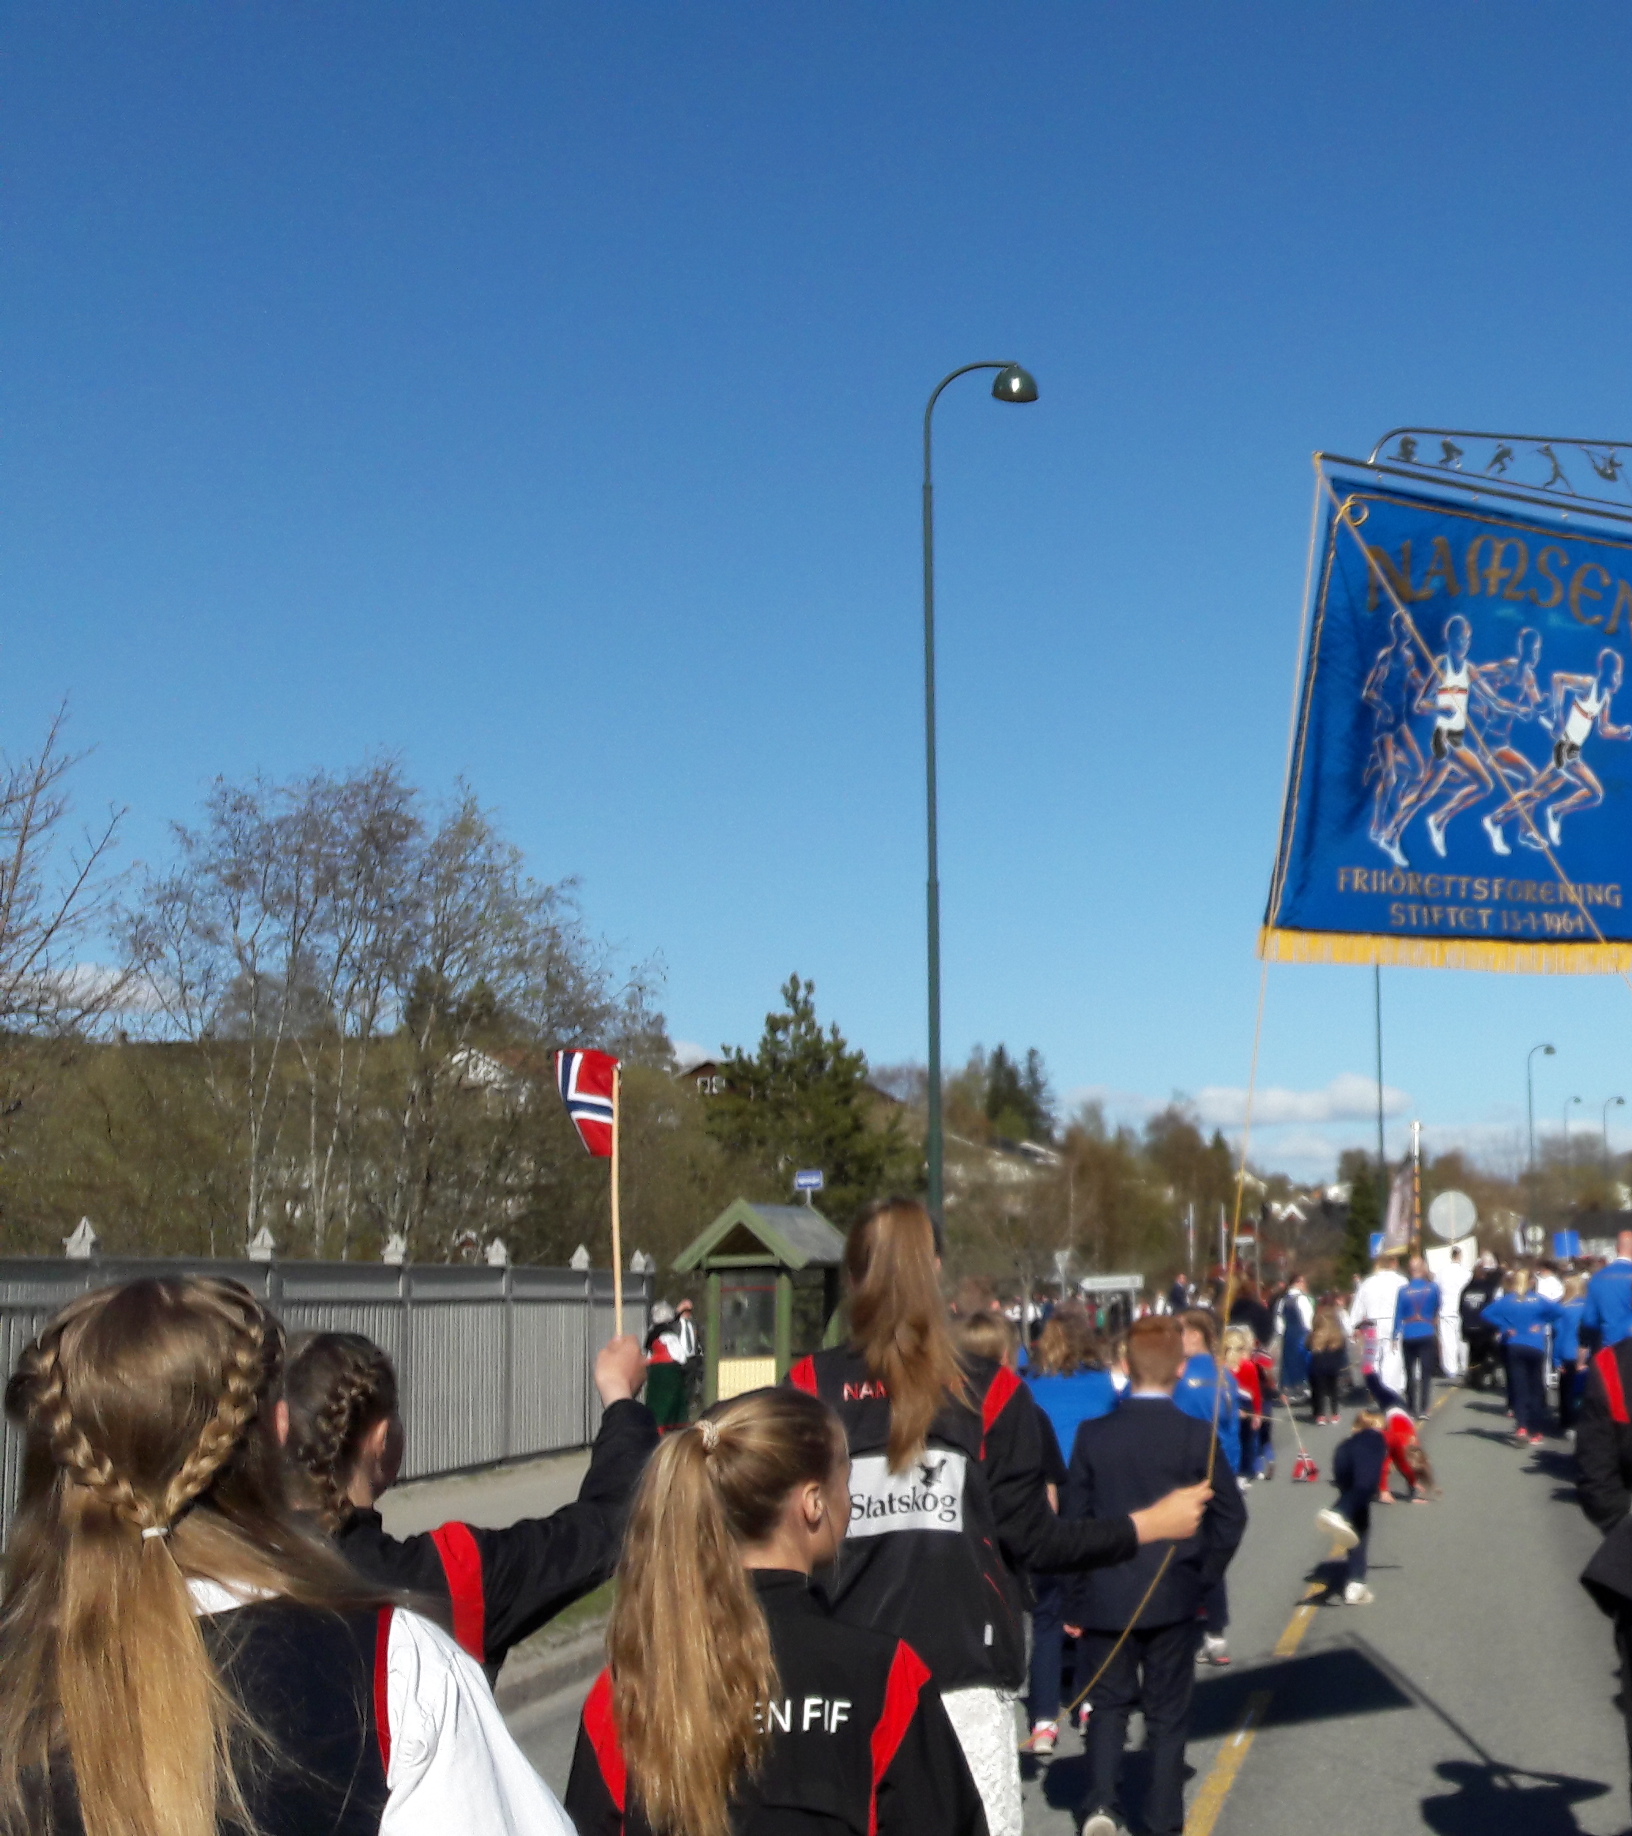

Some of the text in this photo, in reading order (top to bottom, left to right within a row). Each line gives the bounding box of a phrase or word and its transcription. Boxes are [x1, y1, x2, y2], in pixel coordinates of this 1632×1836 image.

[1390, 904, 1493, 930] STIFTET
[850, 1486, 957, 1522] Statskog
[803, 1698, 852, 1733] FIF
